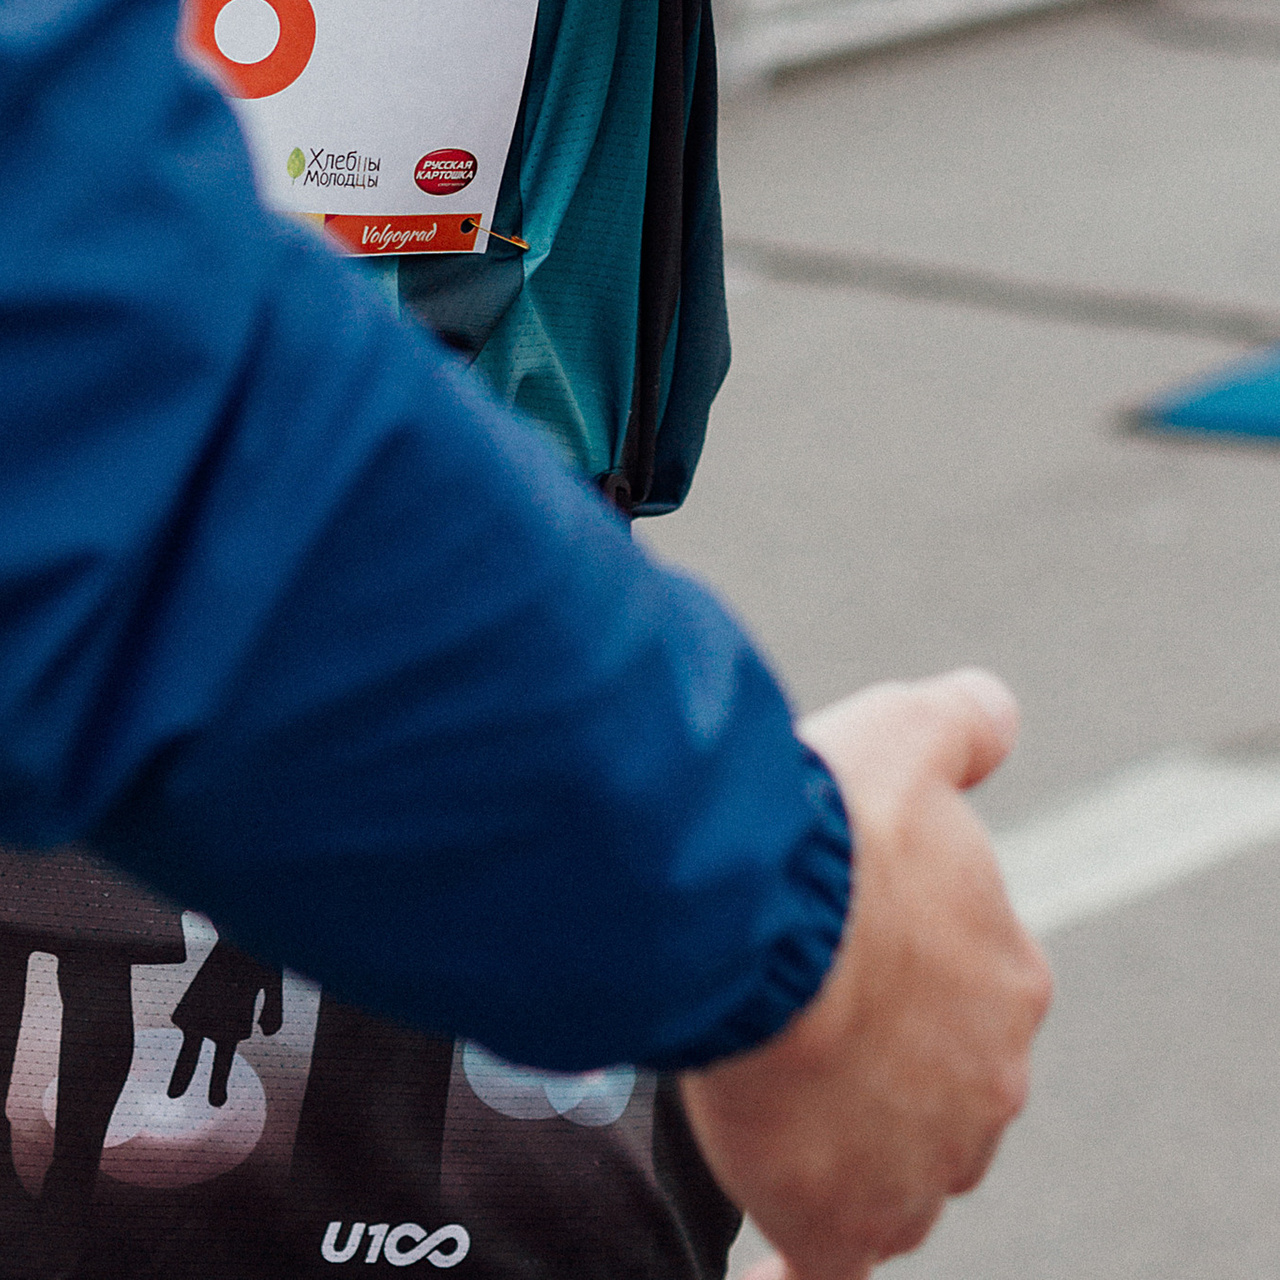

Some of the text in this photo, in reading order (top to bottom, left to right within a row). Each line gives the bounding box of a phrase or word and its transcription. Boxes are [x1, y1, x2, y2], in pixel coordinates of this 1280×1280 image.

[422, 160, 473, 170] РУССКАЯ
[415, 170, 474, 180] КАРТОШКА
[361, 223, 438, 250] Volgograd
